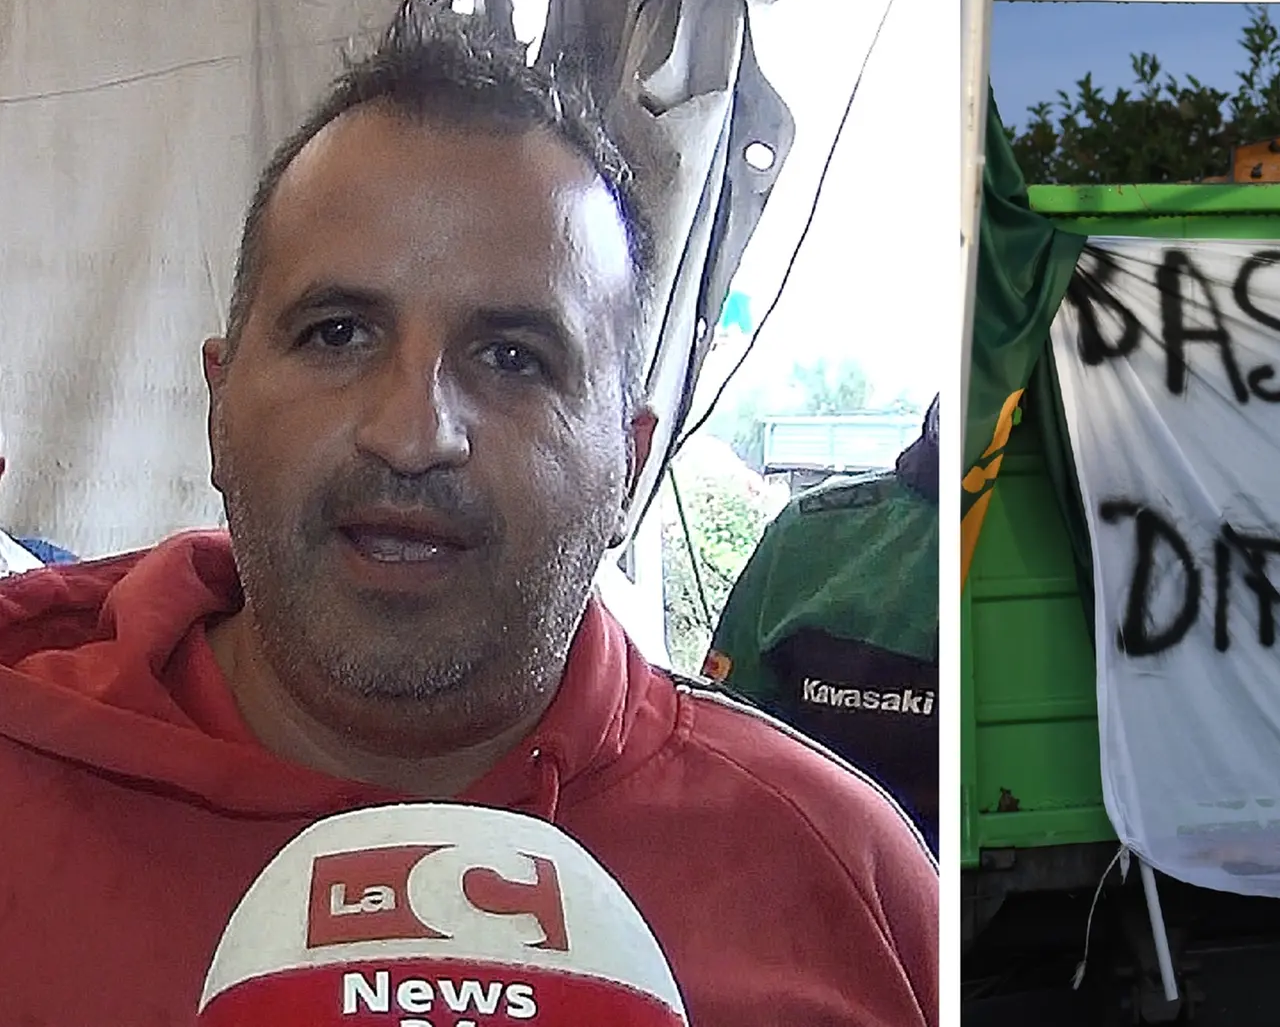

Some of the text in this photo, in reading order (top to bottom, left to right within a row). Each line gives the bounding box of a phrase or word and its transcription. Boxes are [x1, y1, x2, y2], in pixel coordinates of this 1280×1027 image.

[803, 677, 934, 715] Kawasaki
[329, 882, 396, 916] La
[342, 970, 538, 1019] News
